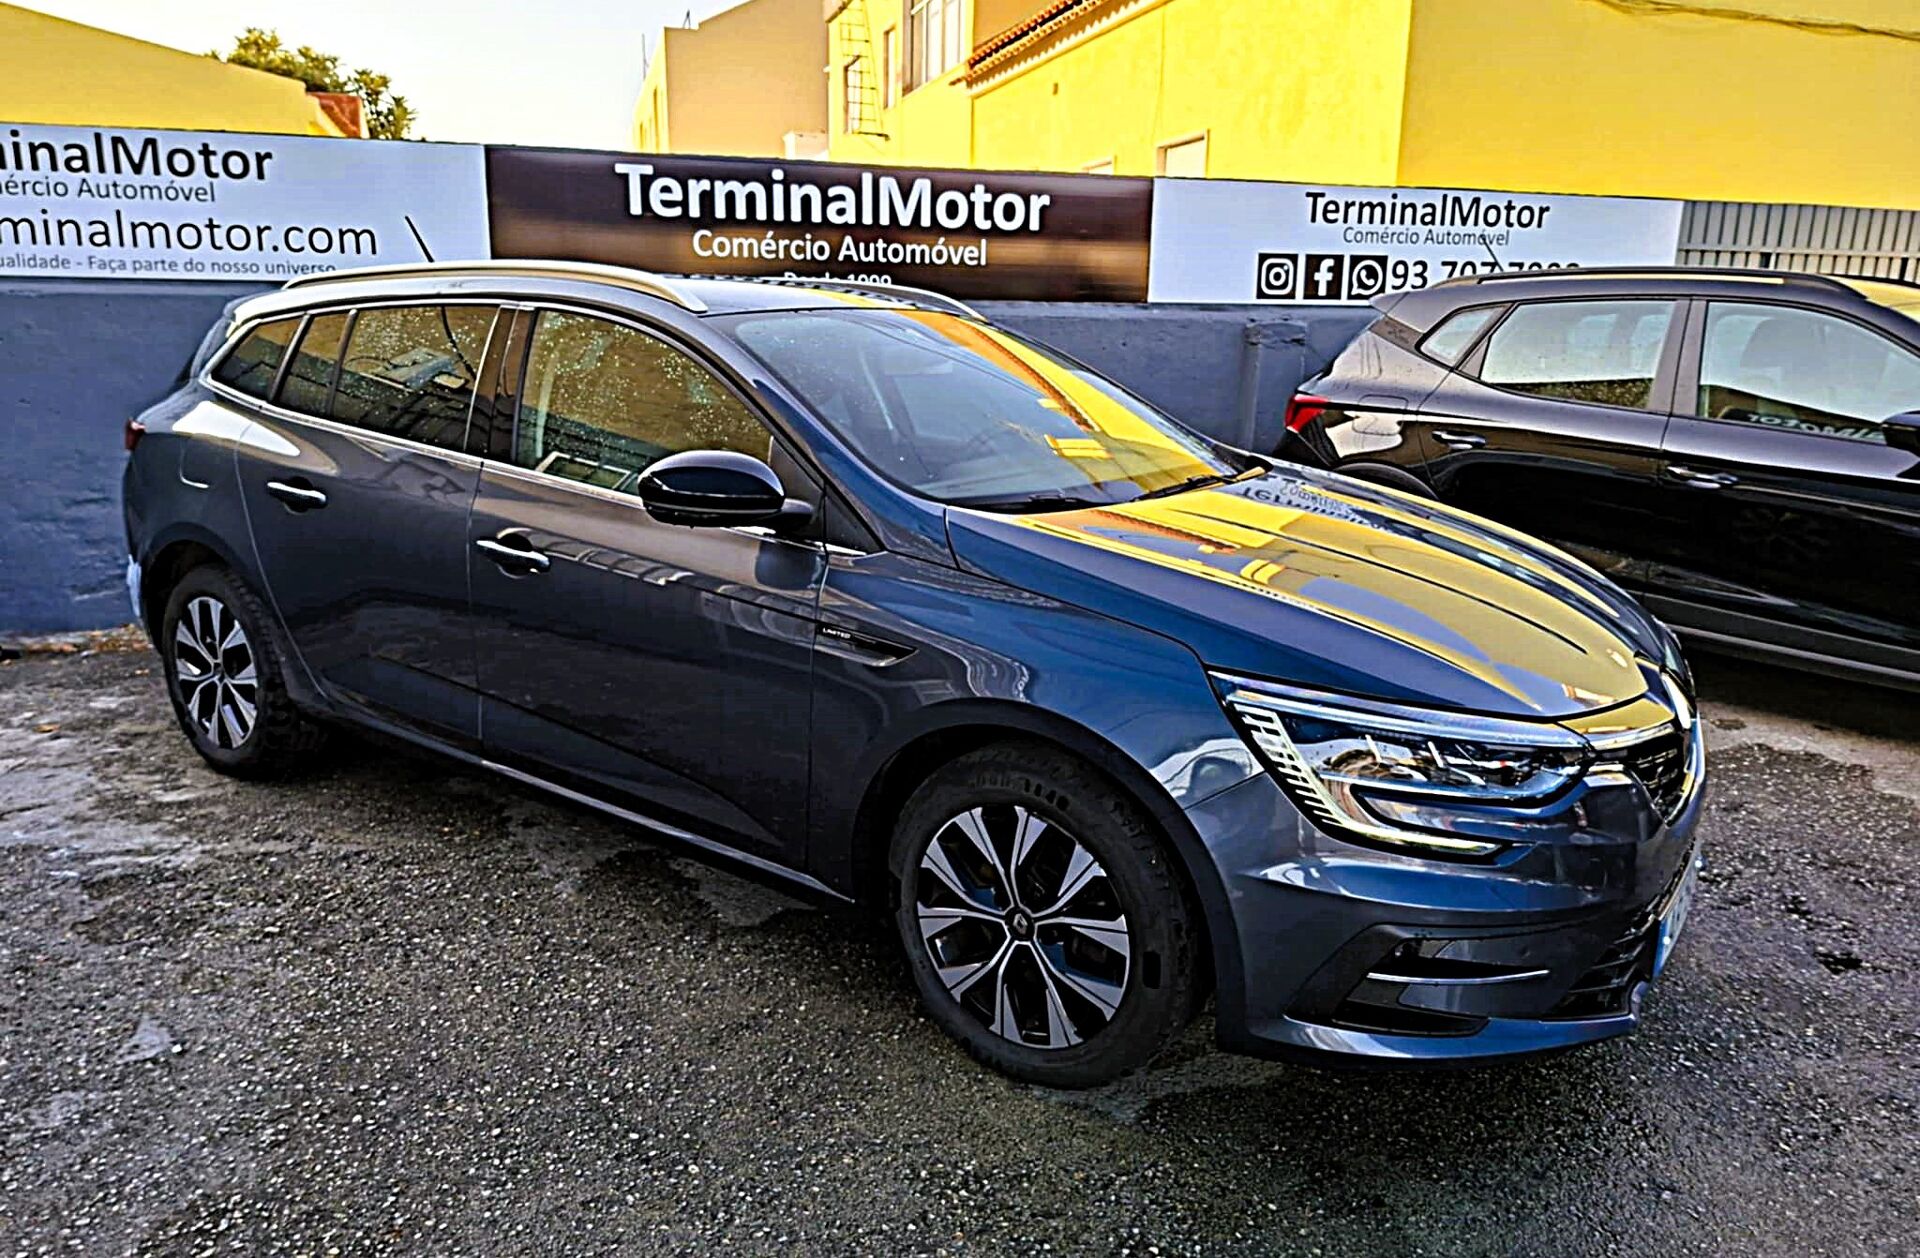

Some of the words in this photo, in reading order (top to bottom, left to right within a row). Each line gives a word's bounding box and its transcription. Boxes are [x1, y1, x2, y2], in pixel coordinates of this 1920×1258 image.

[0, 129, 272, 180] inalMotor
[0, 173, 69, 197] ércio
[77, 178, 216, 202] Automóvel
[614, 162, 1050, 232] TerminalMotor
[1305, 191, 1550, 229] TerminalMotor
[692, 229, 830, 261] Comércio
[838, 237, 987, 266] Automóvel
[1343, 226, 1420, 245] Comércio
[1424, 228, 1510, 246] Automóvel
[88, 256, 127, 273] Faça
[132, 258, 178, 273] parte
[183, 258, 205, 272] do
[211, 261, 260, 274] nosso
[265, 260, 336, 275] universo
[1391, 260, 1428, 290] 93
